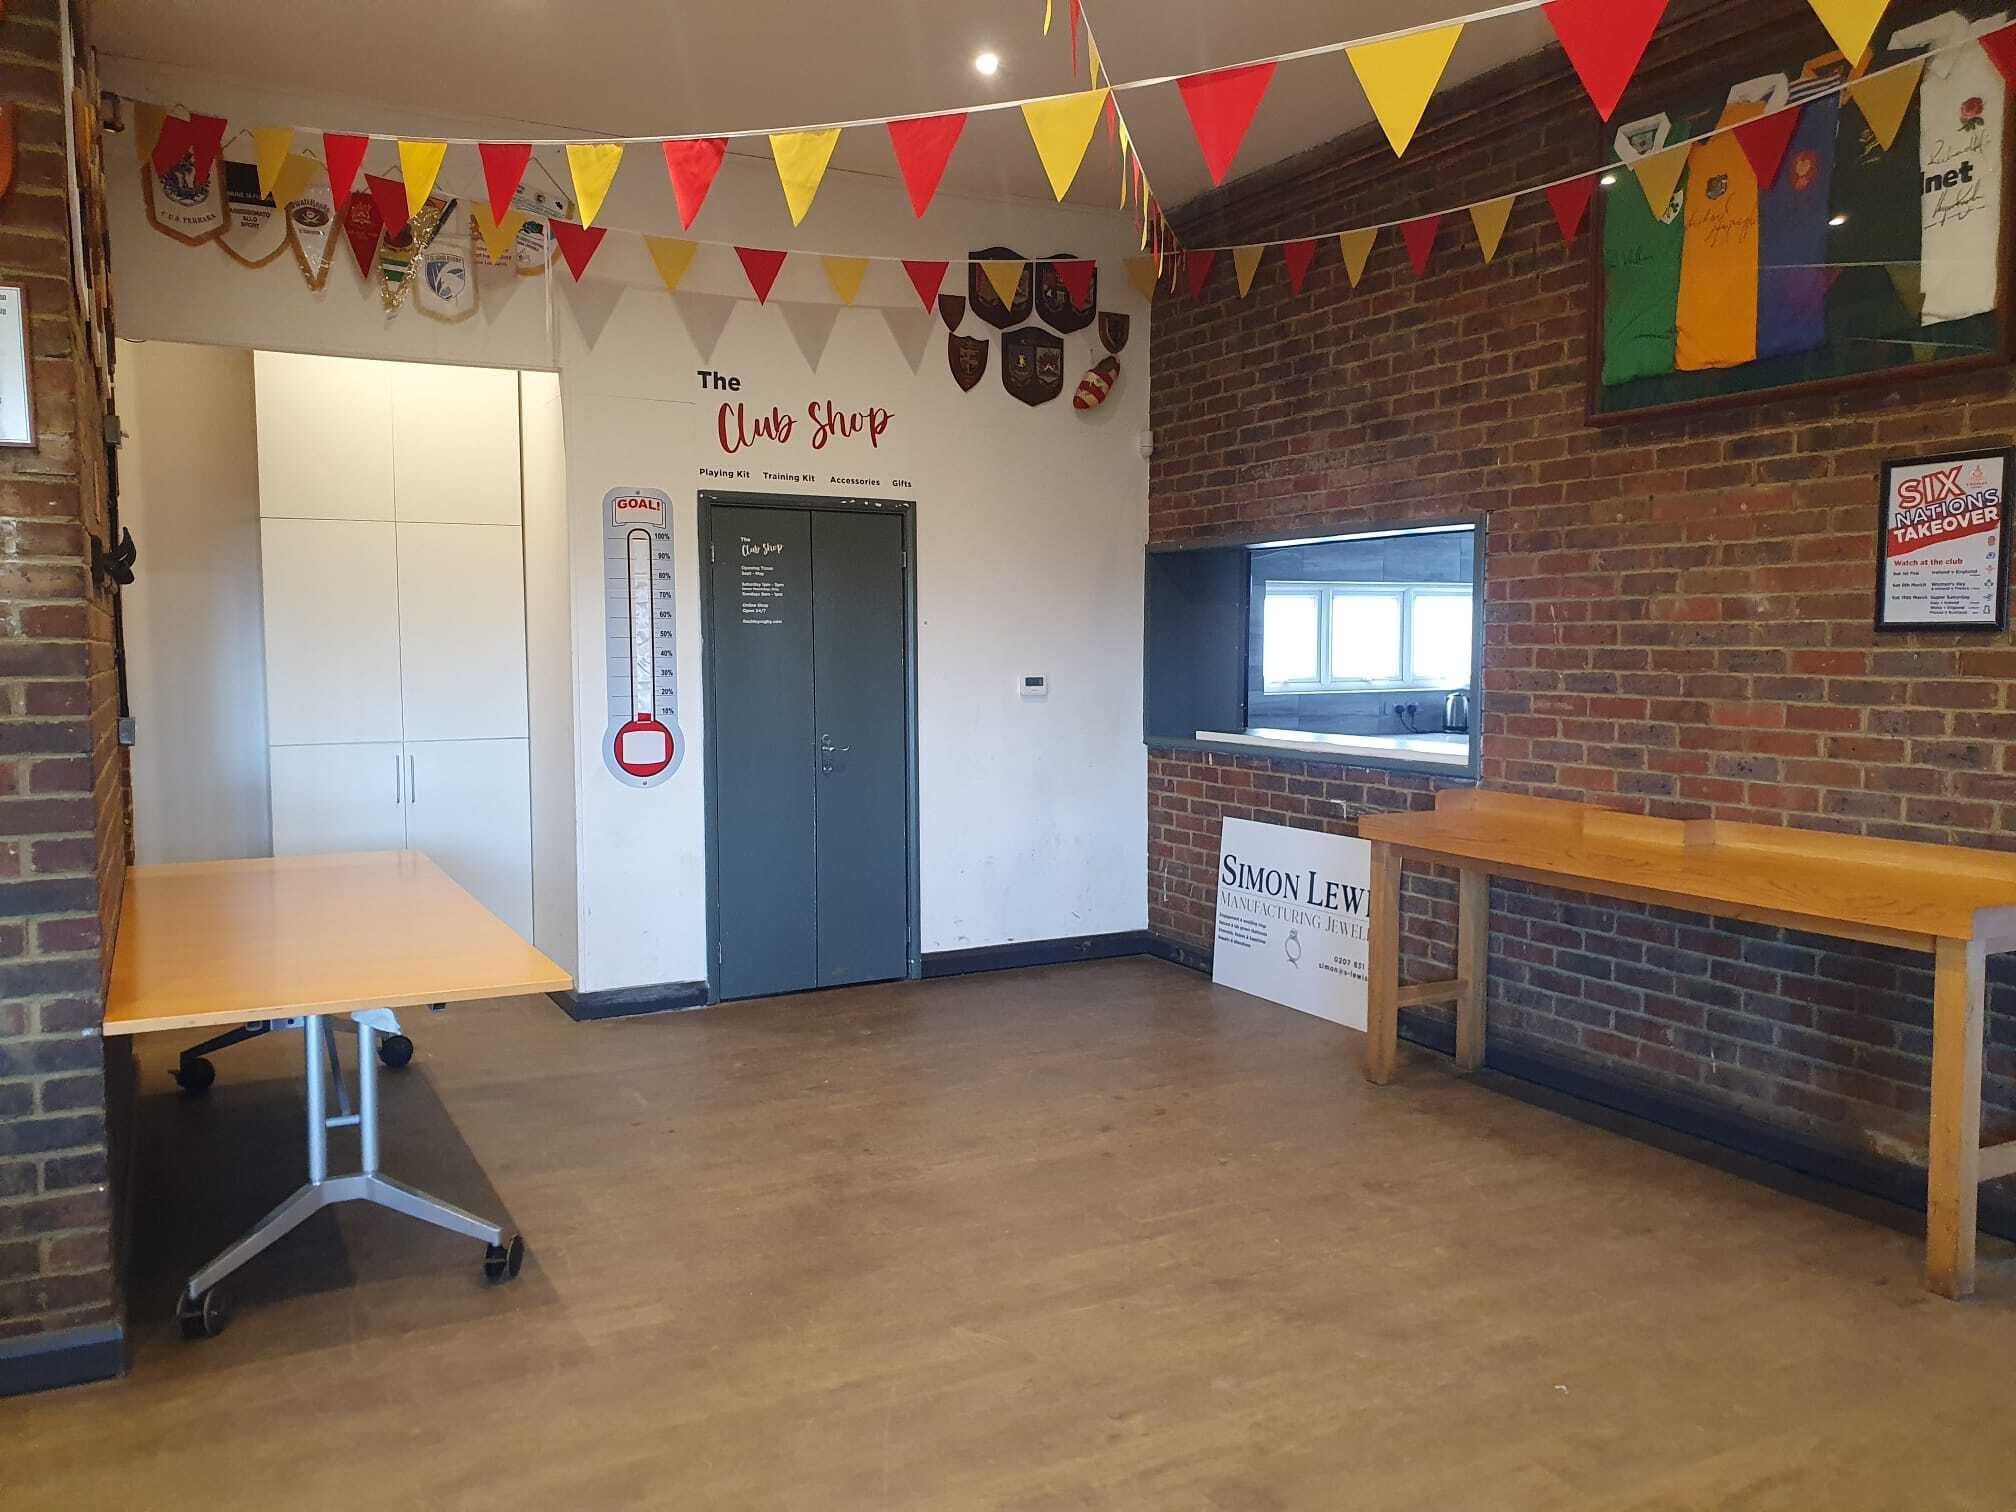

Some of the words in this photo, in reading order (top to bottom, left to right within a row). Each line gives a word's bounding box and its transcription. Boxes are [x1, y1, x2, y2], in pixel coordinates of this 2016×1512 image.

[697, 370, 741, 391] The
[718, 402, 798, 454] Club
[808, 400, 895, 450] Shop
[699, 468, 734, 479] Playing
[736, 469, 750, 479] Kit
[763, 471, 800, 482] Training
[802, 473, 815, 482] Kit
[830, 476, 881, 486] Accessories
[892, 479, 912, 488] Gifts
[1898, 465, 1966, 509] SIX
[617, 499, 661, 511] GOAL!
[1895, 488, 2000, 528] NATIONS
[1894, 507, 2000, 544] TAKEOVER
[741, 543, 760, 557] Club
[762, 543, 783, 555] Shop
[1893, 559, 1919, 567] Watch
[1930, 558, 1943, 566] the
[1222, 854, 1300, 900] SIMON
[1219, 891, 1321, 929] MANUFACTURING
